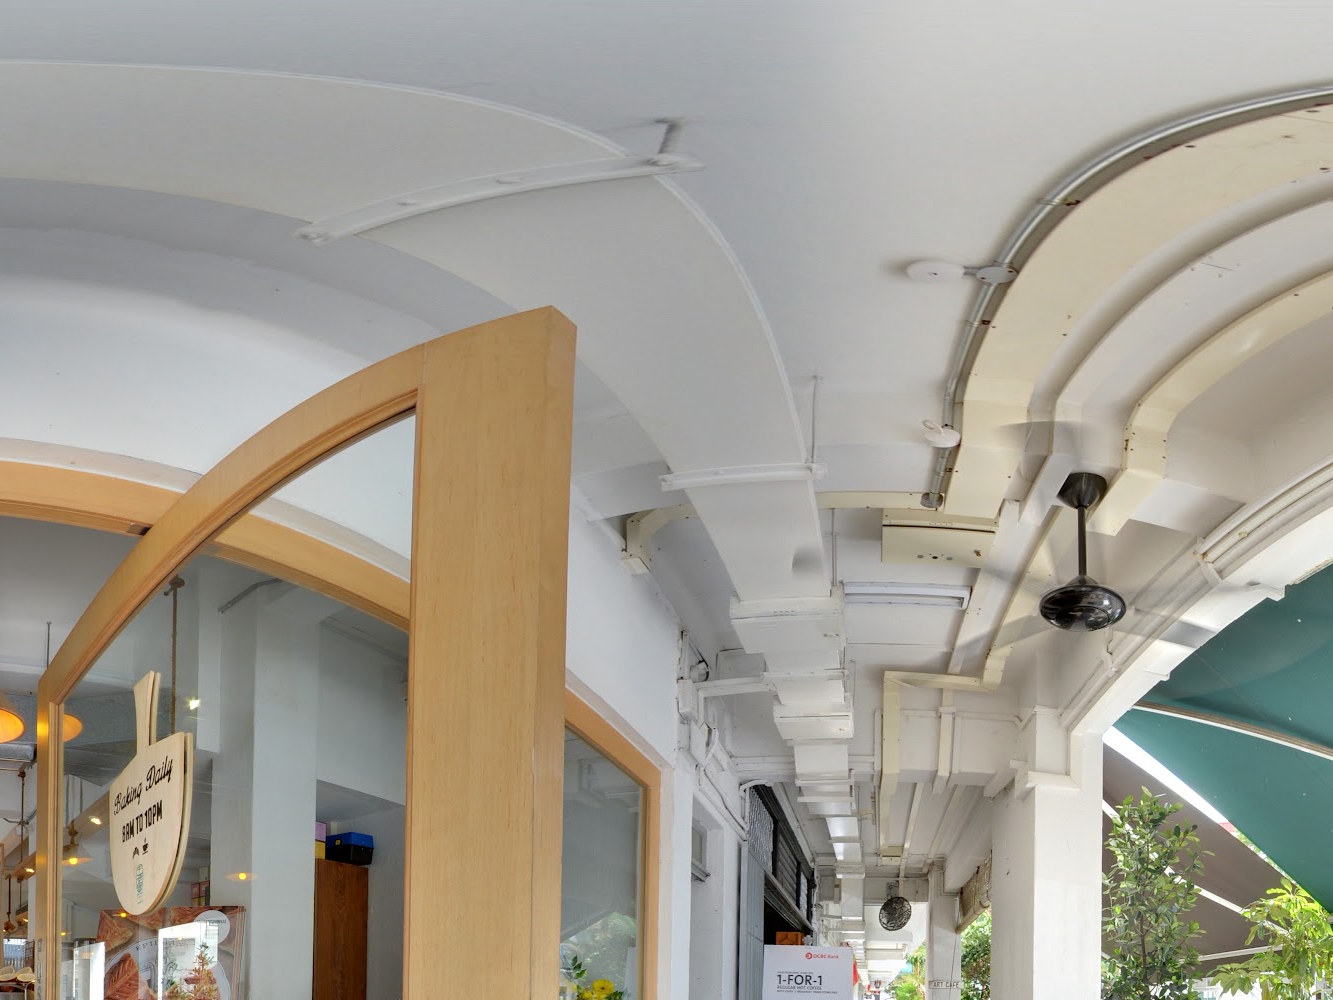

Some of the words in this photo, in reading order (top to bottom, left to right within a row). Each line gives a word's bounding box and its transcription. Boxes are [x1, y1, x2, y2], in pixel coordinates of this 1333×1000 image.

[113, 782, 142, 815] Baking
[145, 755, 173, 791] Daily
[122, 818, 134, 842] 8AM
[136, 813, 143, 834] TO
[144, 800, 162, 829] 10PM
[777, 974, 822, 986] 1-FOR-1
